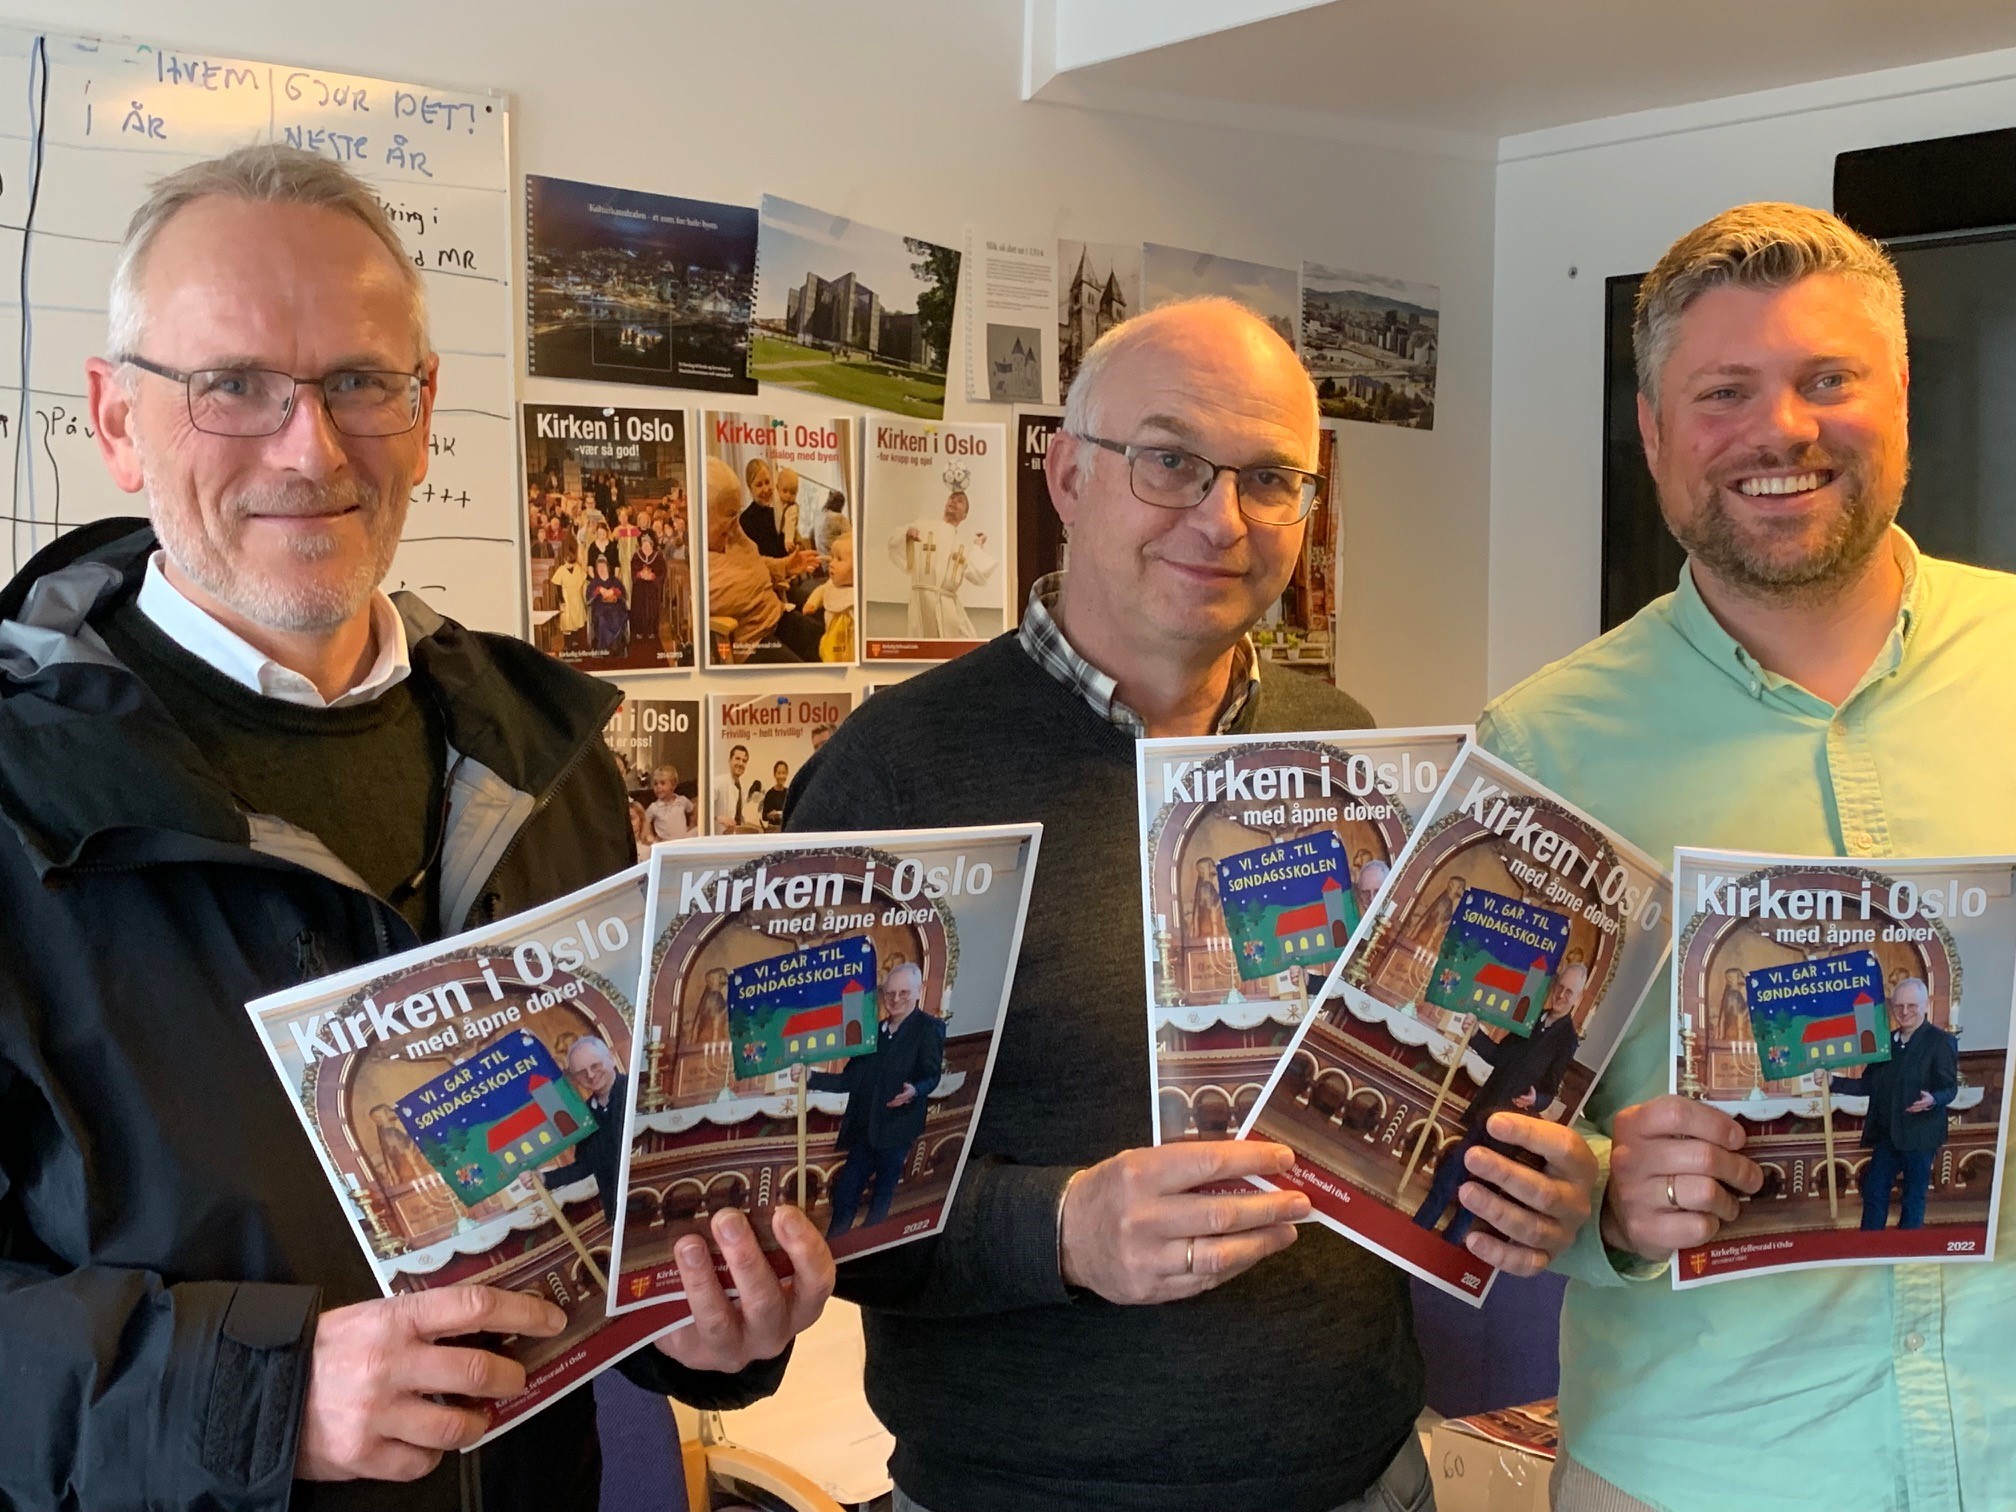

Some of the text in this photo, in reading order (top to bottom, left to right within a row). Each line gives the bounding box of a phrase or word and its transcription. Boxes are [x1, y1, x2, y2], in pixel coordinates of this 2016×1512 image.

[122, 100, 168, 140] ÅR
[386, 133, 434, 178] ÅR
[438, 247, 478, 270] MR
[536, 412, 675, 442] Kirken i Oslo
[715, 419, 839, 449] Kirken i Oslo
[877, 426, 988, 456] Kirken i Oslo
[1026, 425, 1061, 454] Kir
[601, 441, 614, 456] så
[616, 443, 640, 459] god!
[769, 449, 796, 462] dialog
[797, 450, 816, 461] med
[817, 451, 840, 464] byen
[630, 708, 636, 732] i
[642, 707, 690, 733] Oslo
[721, 701, 840, 726] Kirken i Oslo
[630, 735, 653, 749] oss!
[758, 727, 774, 738] helt
[1162, 752, 1439, 804] Kirken i Oslo
[1243, 804, 1286, 827] med
[1291, 802, 1338, 827] åpne
[1343, 802, 1394, 821] dører
[1238, 857, 1252, 871] VI
[1293, 841, 1318, 858] TIL
[1458, 775, 1663, 933] Kirken i Oslo
[678, 854, 994, 916] Kirken i Oslo
[1228, 857, 1337, 892] SØNDAGSSKOLEN
[1509, 855, 1551, 891] med
[1548, 877, 1590, 914] åpne
[1583, 903, 1620, 937] dører
[1696, 873, 1988, 921] Kirken i Oslo
[767, 911, 817, 936] med
[820, 908, 876, 936] åpne
[881, 906, 938, 927] dører
[1483, 896, 1496, 912] VI
[1532, 913, 1550, 931] TIL
[1462, 908, 1557, 954] SØNDAGSSKOLEN
[1776, 925, 1820, 944] med
[1826, 923, 1877, 947] åpne
[1881, 924, 1937, 943] dører
[754, 965, 769, 979] VI
[819, 946, 846, 963] TIL
[1768, 971, 1783, 984] VI
[1826, 960, 1853, 974] TIL
[287, 915, 630, 1065] Kirken i Oslo
[738, 961, 864, 1000] SØNDAGSSKOLEN
[1756, 974, 1871, 1003] SØNDAGSSKOLEN
[404, 1029, 460, 1060] med
[463, 1003, 522, 1048] åpne
[525, 977, 587, 1016] dører
[414, 1054, 539, 1130] SØNDAGSSKOLEN
[418, 1089, 438, 1105] VI
[479, 1050, 510, 1071] TIL
[902, 1218, 931, 1235] 2022
[1946, 1240, 1976, 1252] 2022
[1460, 1271, 1482, 1290] 2022
[1443, 1450, 1466, 1479] 60
